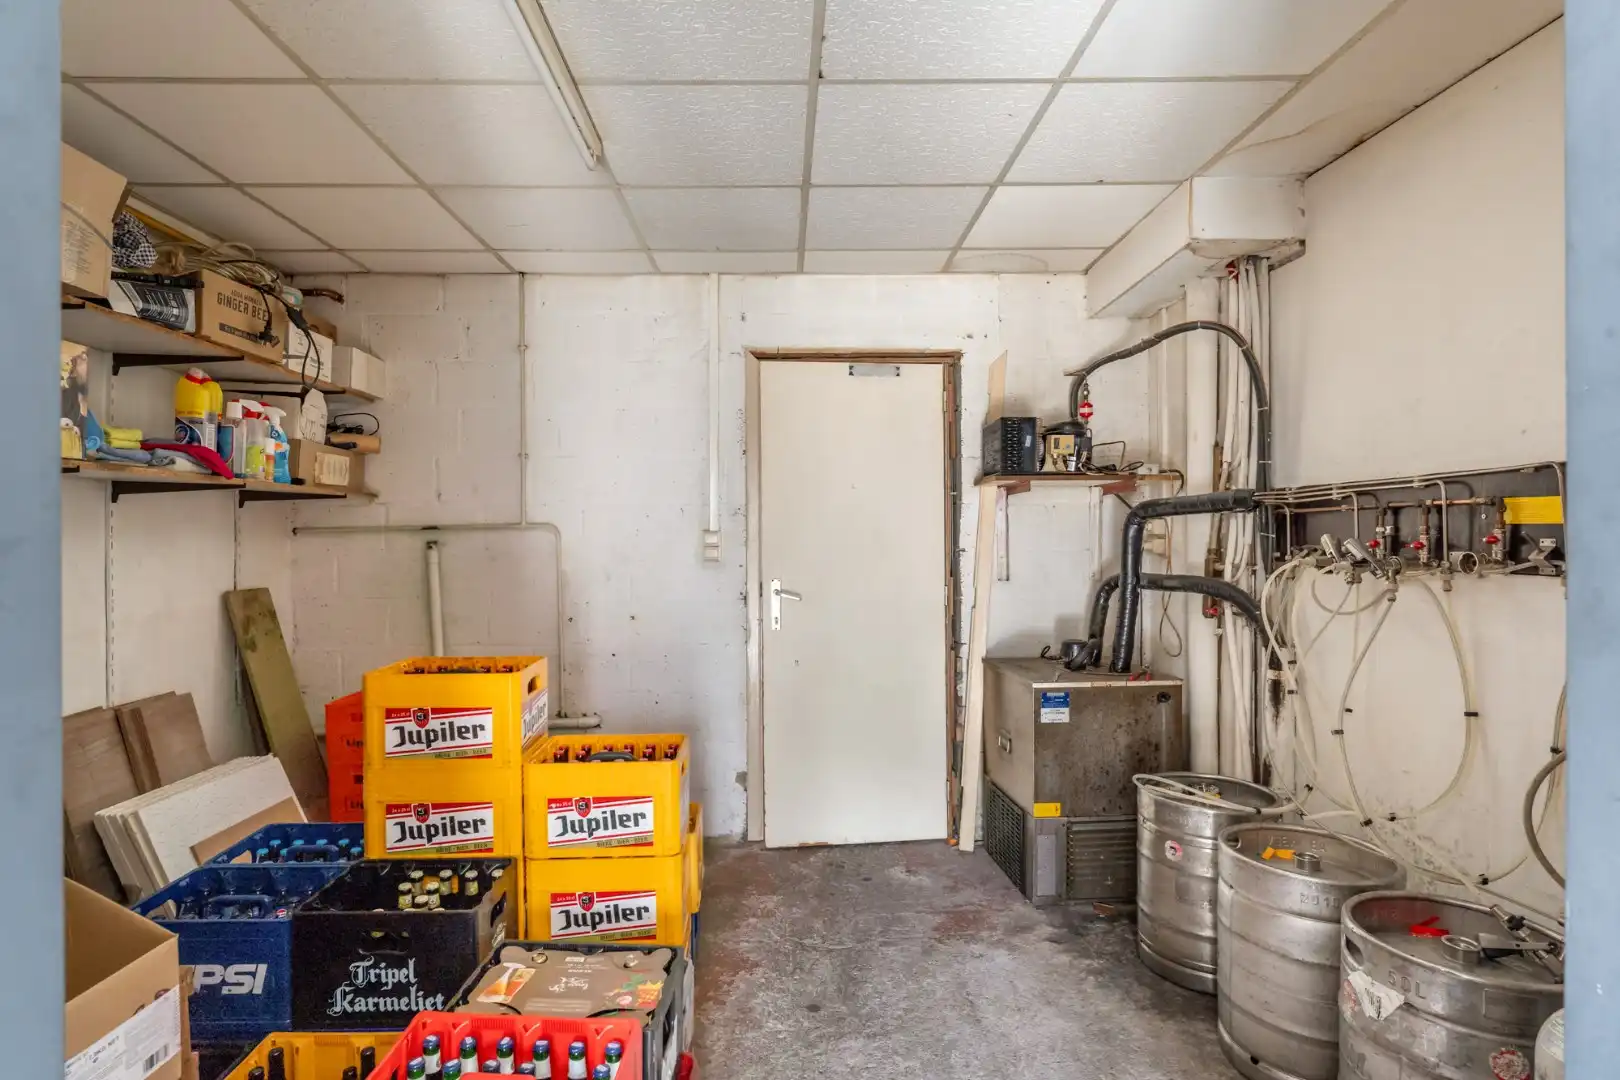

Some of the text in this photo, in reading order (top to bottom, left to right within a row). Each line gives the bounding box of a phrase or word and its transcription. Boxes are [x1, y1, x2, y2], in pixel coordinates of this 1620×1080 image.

[216, 291, 271, 322] GINGER BEE
[391, 720, 486, 750] Jupiler
[522, 701, 547, 739] Jupiler
[392, 815, 487, 844] Jupiler
[554, 809, 647, 838] Jupiler
[557, 903, 650, 931] Jupiler
[349, 955, 418, 990] Tripel
[326, 981, 445, 1017] Karmeliet
